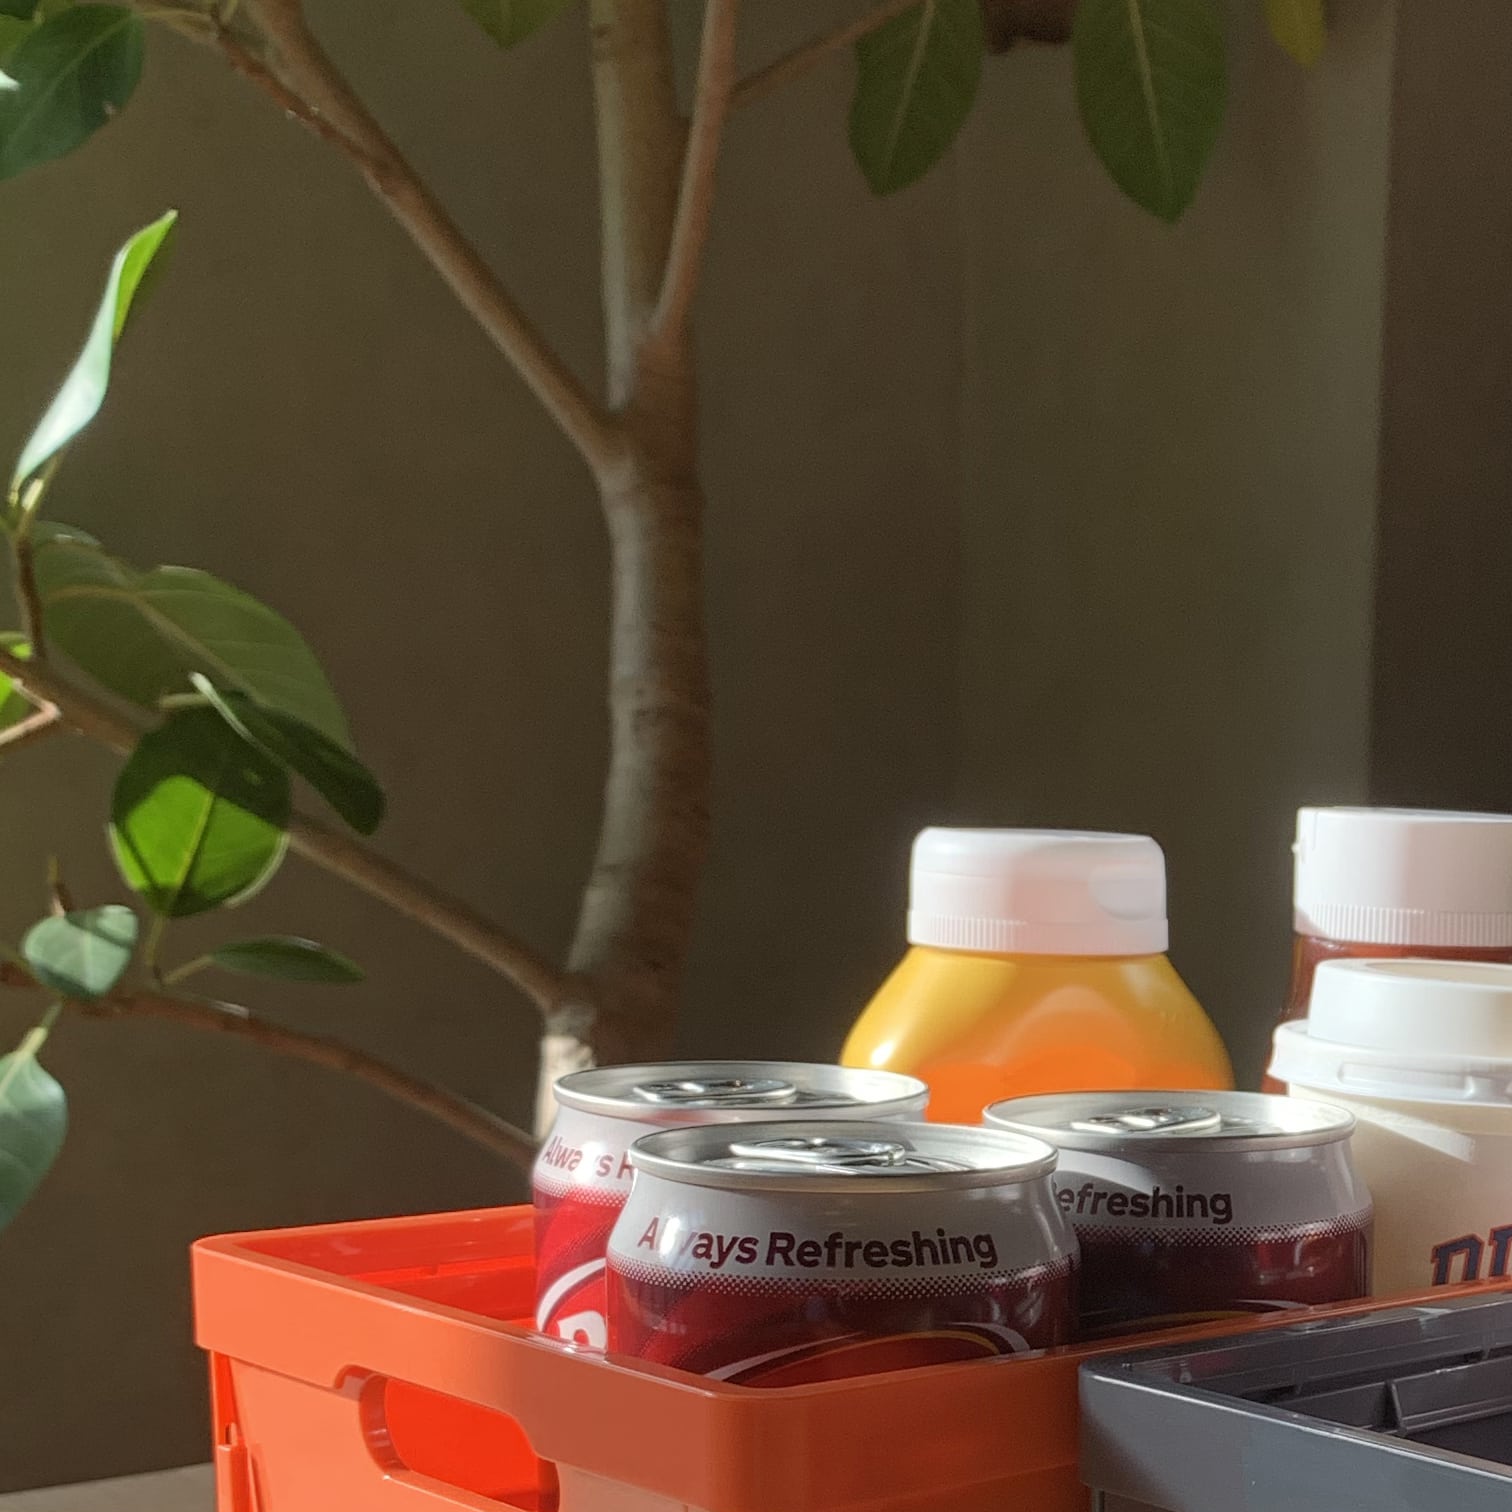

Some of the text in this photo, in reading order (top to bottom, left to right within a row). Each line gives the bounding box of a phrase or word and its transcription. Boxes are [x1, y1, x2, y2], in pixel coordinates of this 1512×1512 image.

[542, 1134, 615, 1178] Alwas
[1053, 1182, 1233, 1225] efreshing
[636, 1215, 999, 1270] Aays Refreshing
